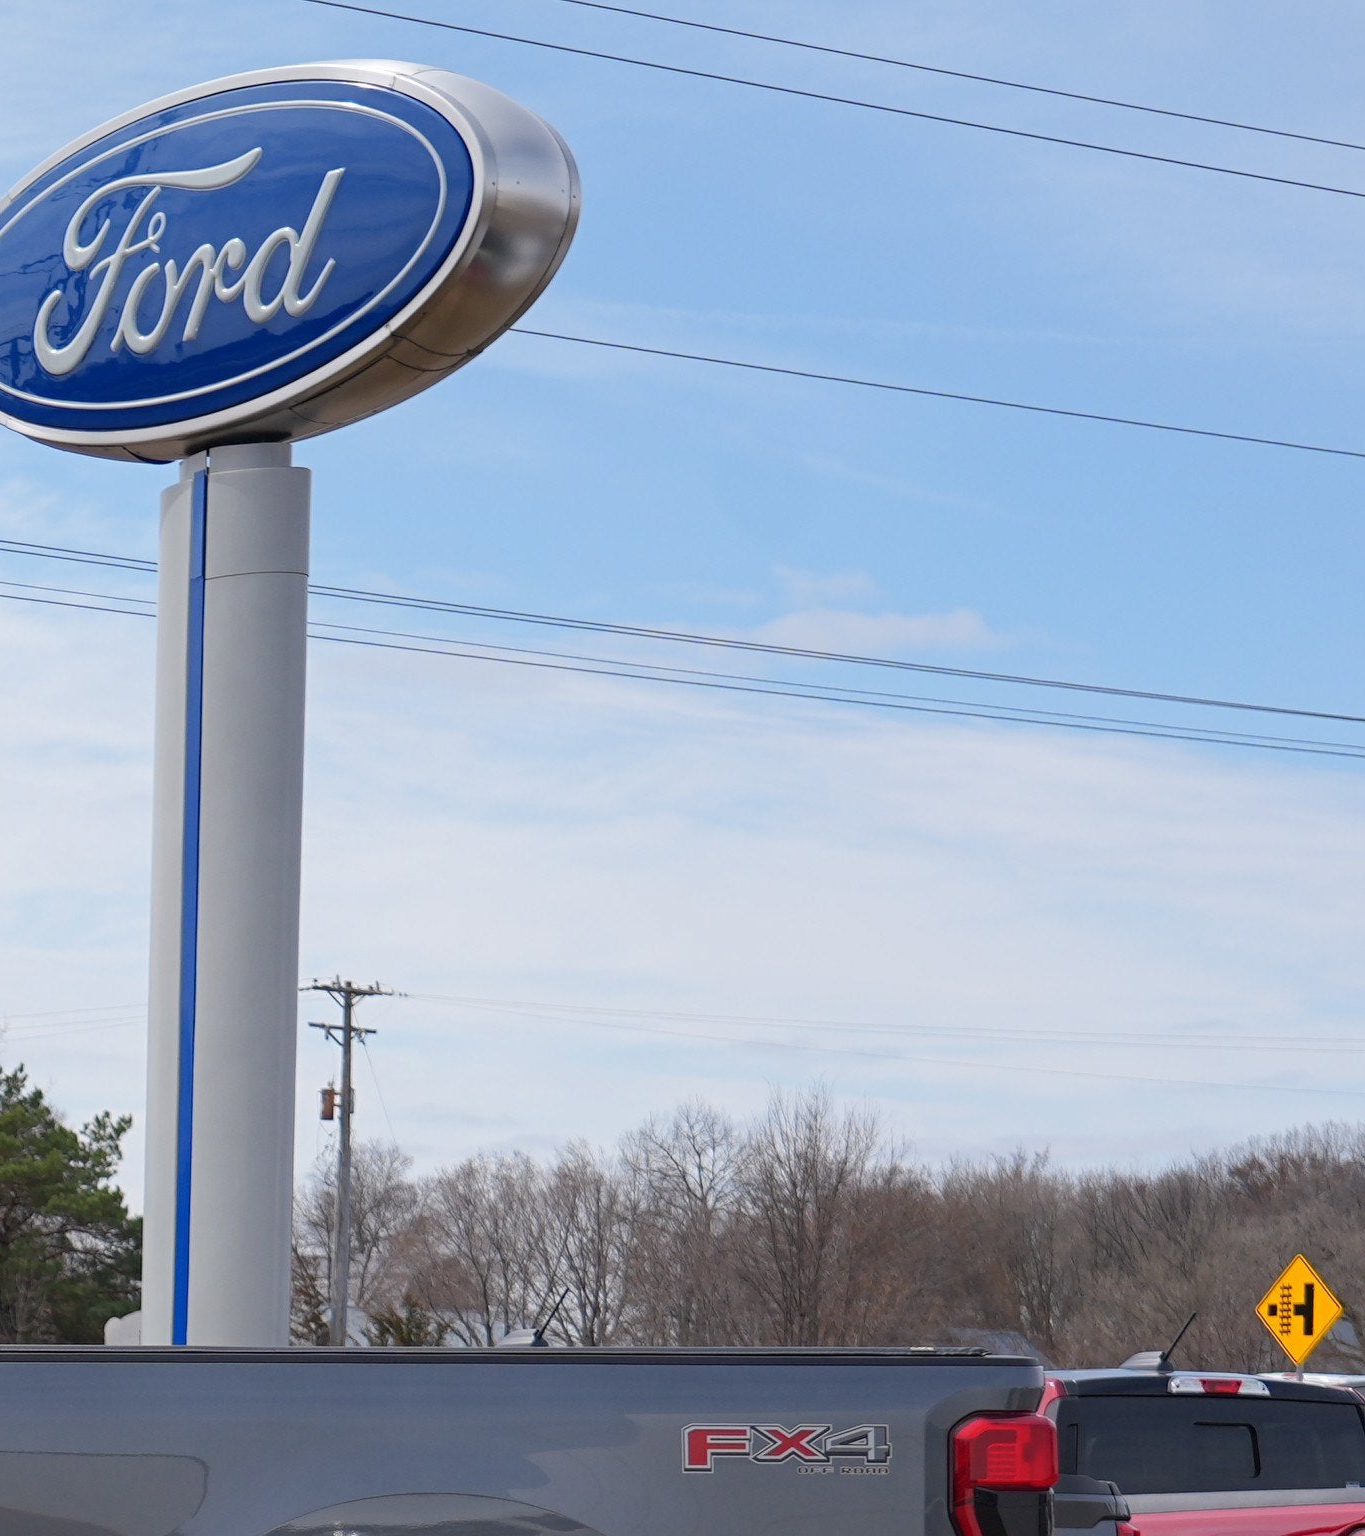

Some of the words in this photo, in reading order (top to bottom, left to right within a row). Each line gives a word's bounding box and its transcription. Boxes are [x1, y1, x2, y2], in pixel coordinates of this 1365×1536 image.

[33, 146, 346, 376] Ford
[681, 1423, 892, 1474] FX4
[797, 1465, 836, 1475] OFF
[840, 1465, 891, 1475] ROAD
